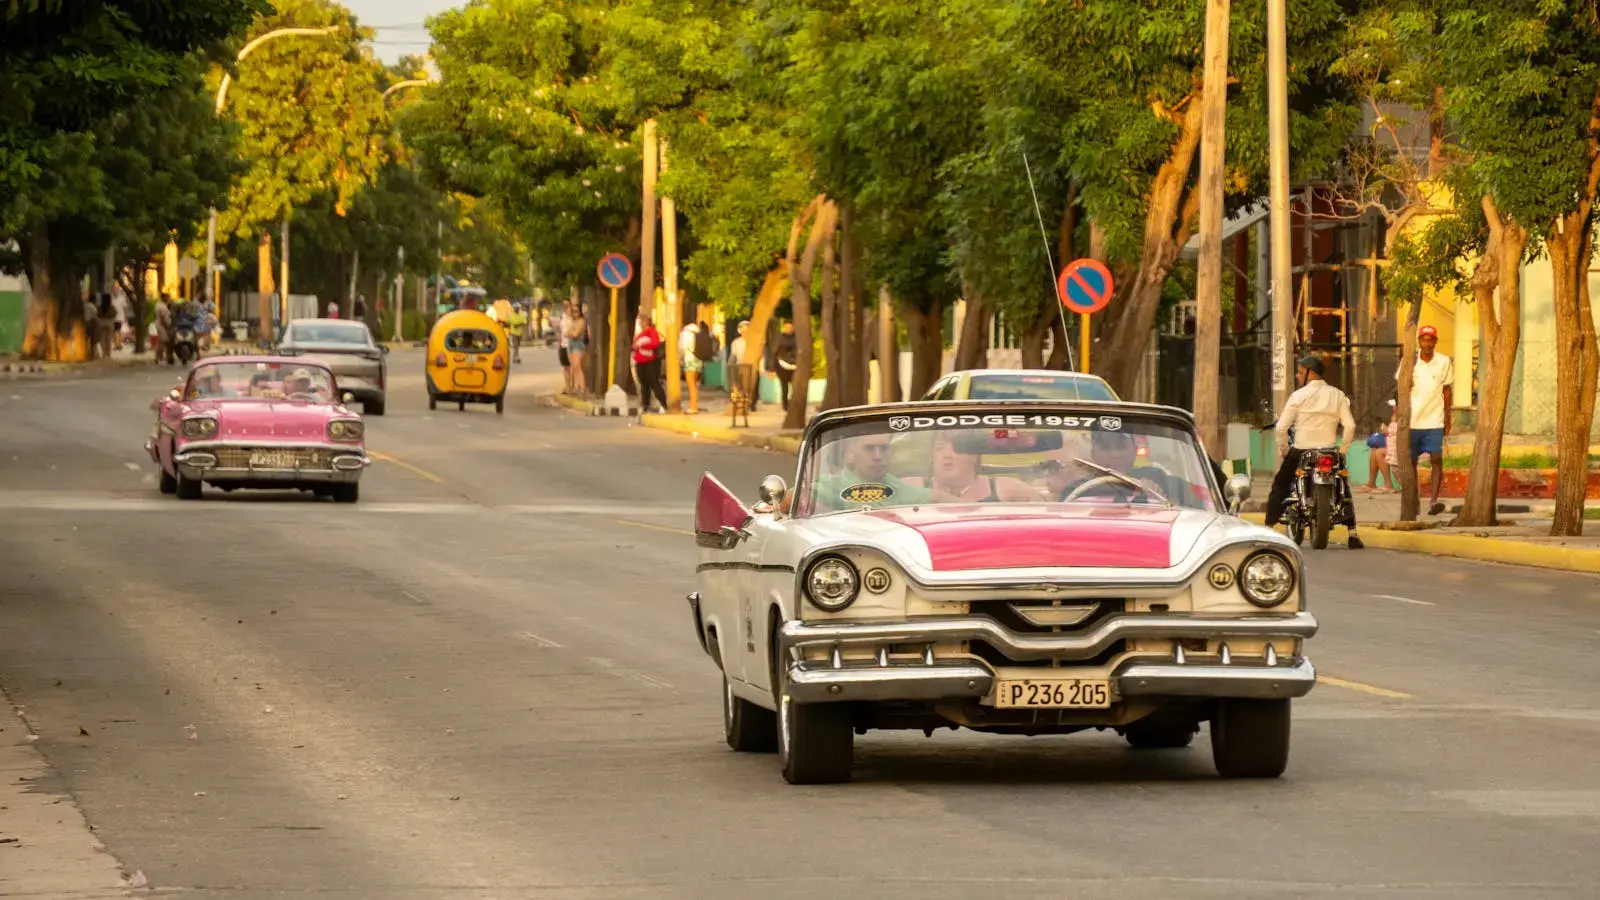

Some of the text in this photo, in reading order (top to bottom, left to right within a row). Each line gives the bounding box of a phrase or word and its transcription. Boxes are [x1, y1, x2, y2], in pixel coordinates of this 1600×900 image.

[1011, 684, 1106, 705] P 236 205
